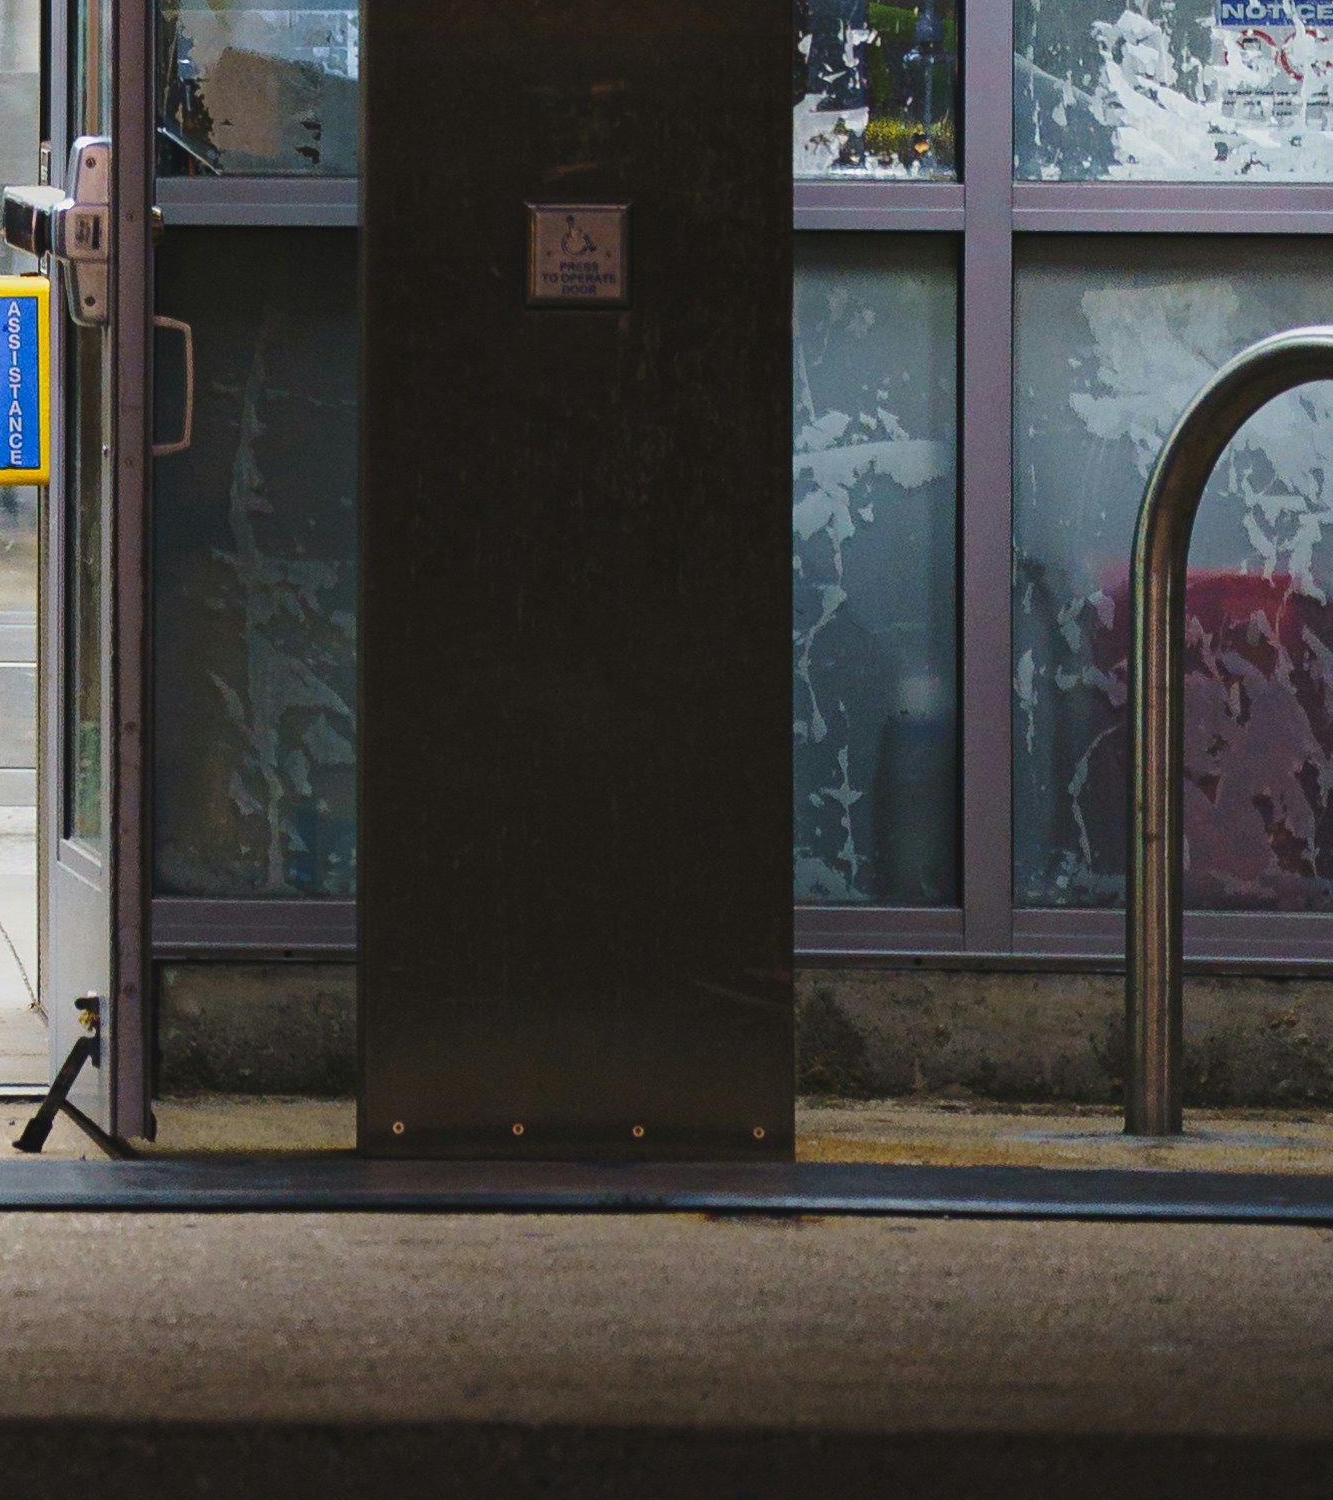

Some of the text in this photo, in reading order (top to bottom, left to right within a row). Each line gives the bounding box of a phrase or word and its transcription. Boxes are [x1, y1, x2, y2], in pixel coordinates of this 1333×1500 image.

[1221, 3, 1333, 20] NOTCE
[560, 262, 598, 271] PRESS
[542, 273, 616, 283] TO OPERATE
[562, 285, 596, 294] DOOR
[7, 300, 23, 466] ASSISTANCE
